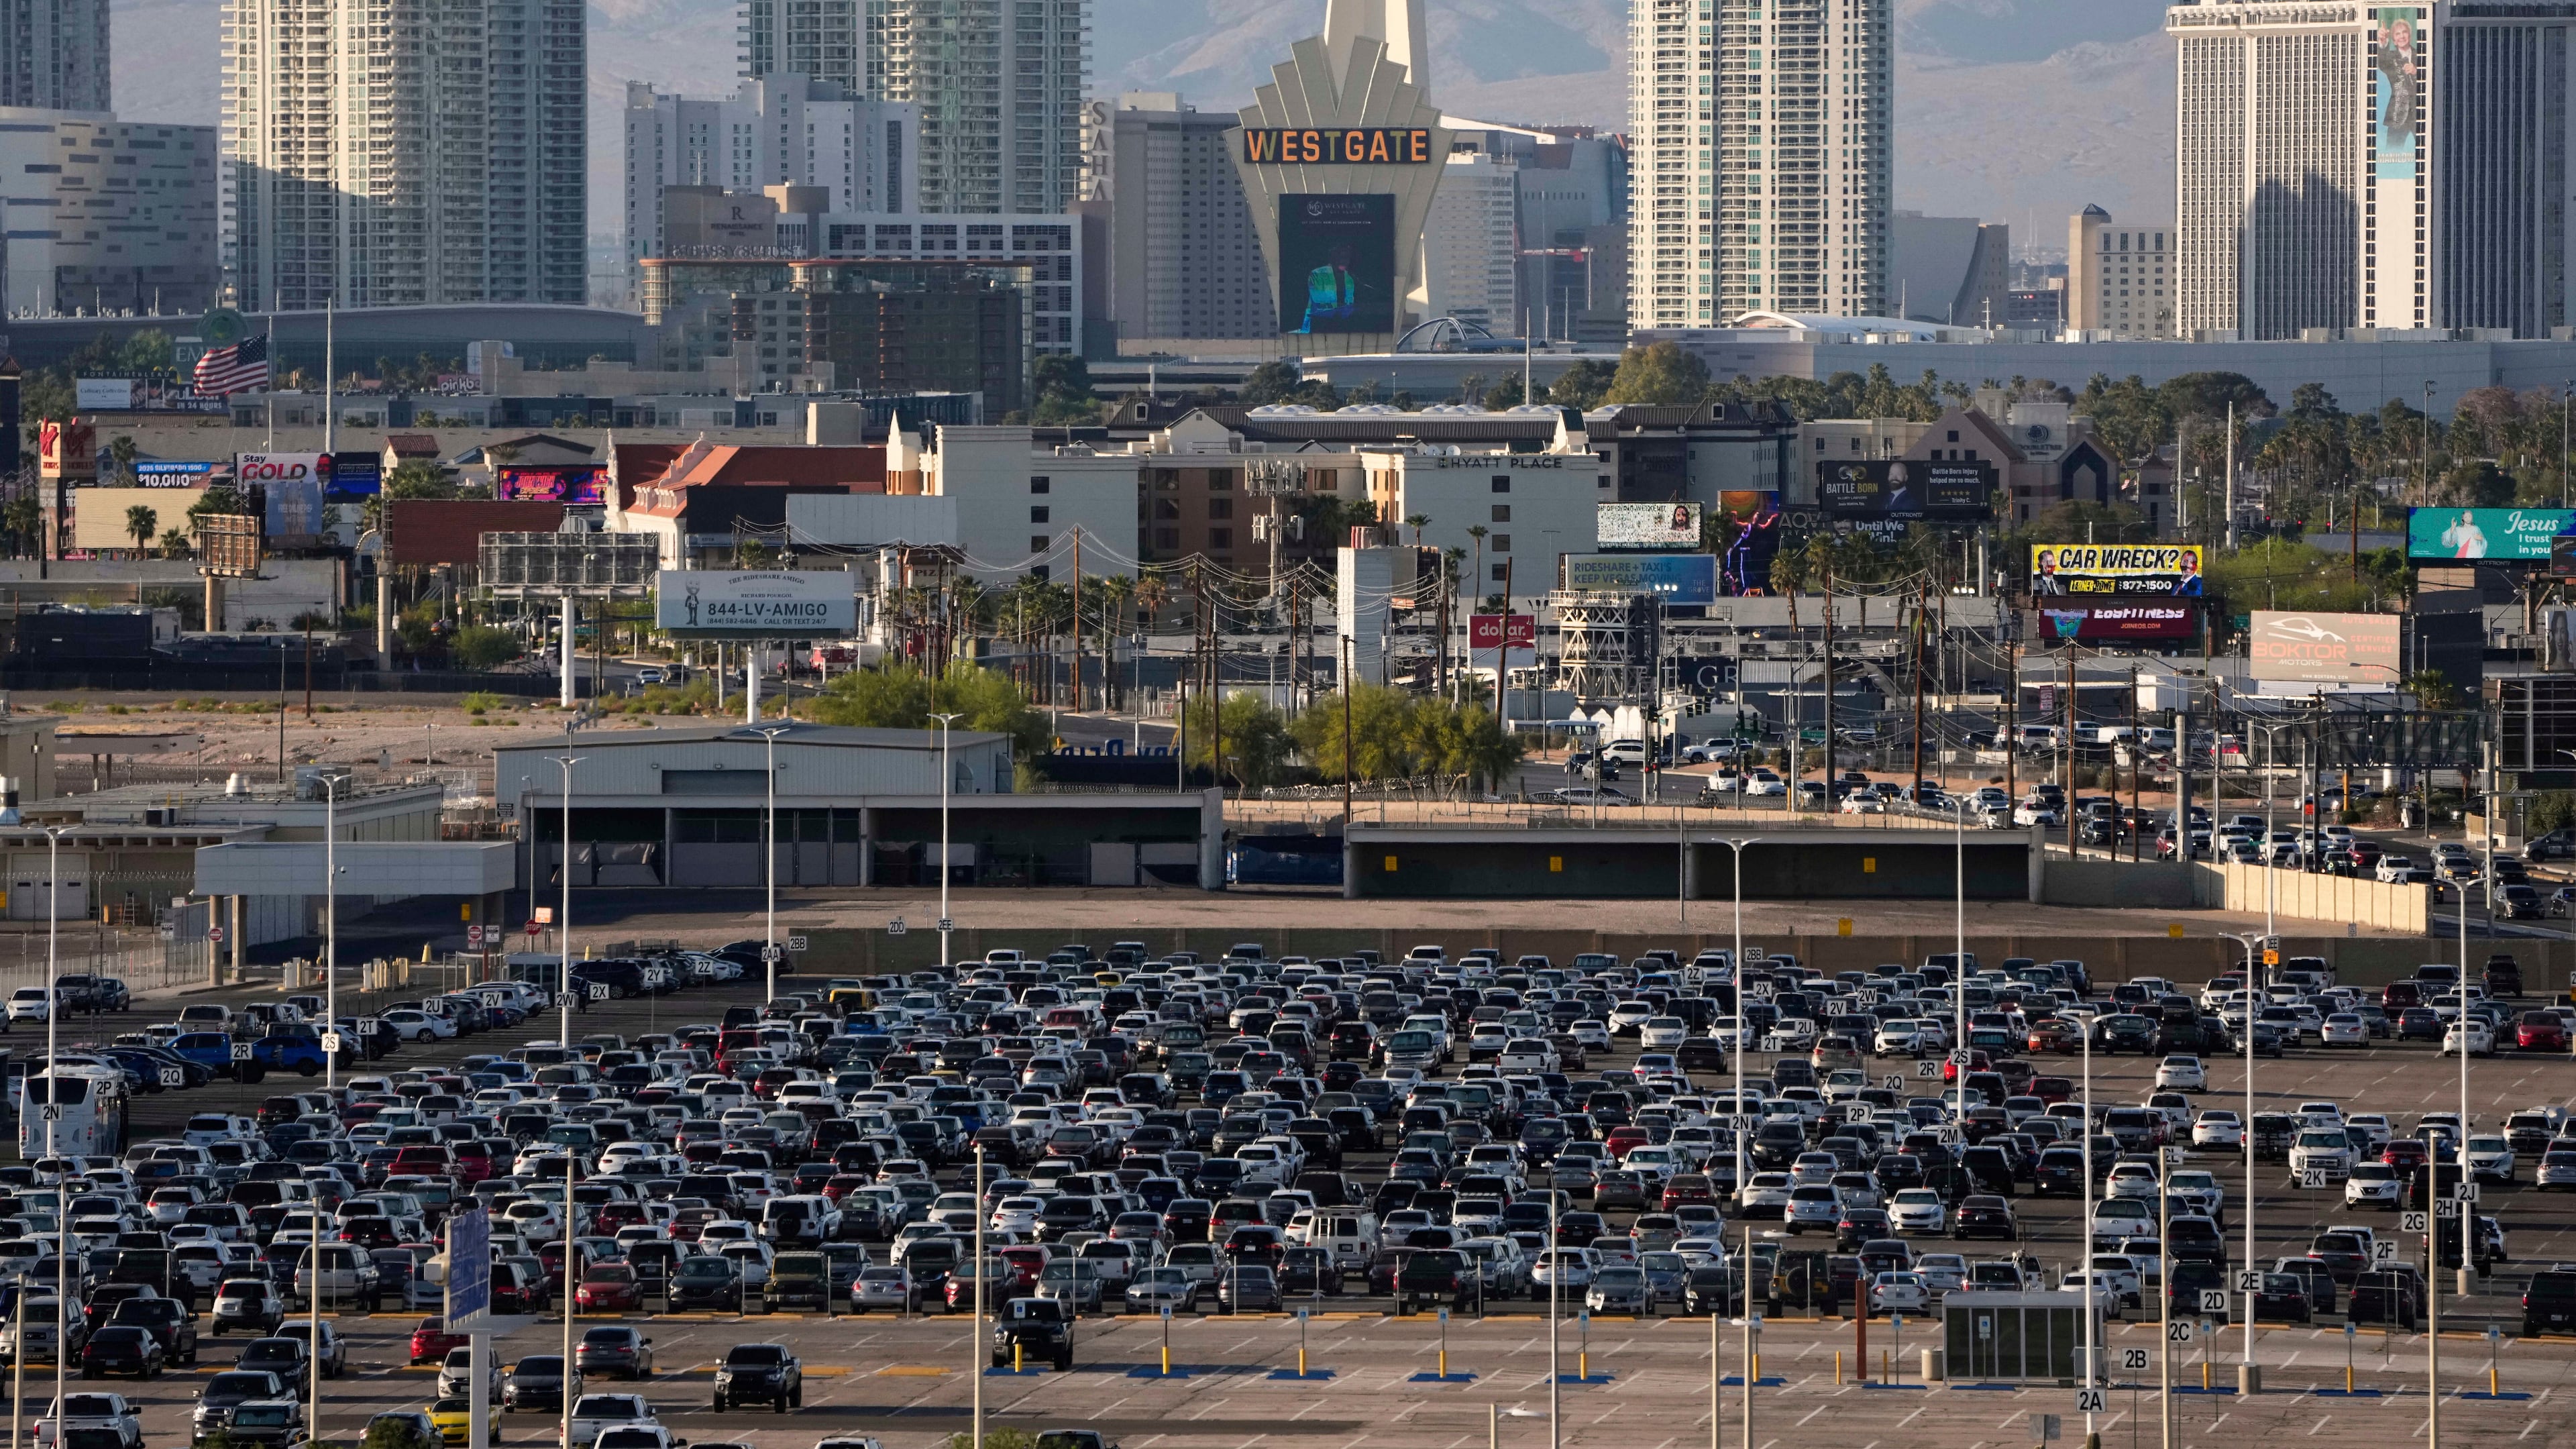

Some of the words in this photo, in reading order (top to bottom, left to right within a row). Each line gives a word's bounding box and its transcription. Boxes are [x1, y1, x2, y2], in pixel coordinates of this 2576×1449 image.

[1247, 131, 1427, 162] WESTGATE
[243, 455, 266, 464] Stay
[1451, 458, 1501, 468] HYATT
[1510, 458, 1562, 468] PLACE
[242, 463, 307, 480] GOLD
[1826, 483, 1855, 494] BATTLE
[1857, 482, 1878, 493] BORN
[1856, 521, 1883, 531] Until
[1885, 521, 1904, 531] We
[2504, 511, 2559, 534] Jesus
[2518, 534, 2522, 542] I
[2524, 534, 2550, 542] trust
[2519, 545, 2529, 553] in
[2531, 546, 2551, 555] you
[2059, 549, 2097, 569] CAR
[2101, 549, 2180, 569] WRECK?
[1574, 563, 1630, 572] RIDESHARE
[1640, 563, 1672, 572] TAXI'S
[728, 576, 742, 585] THE
[782, 576, 805, 585] AMIGO
[1574, 574, 1599, 584] KEEP
[1603, 574, 1638, 584] VEGAS
[1639, 574, 1682, 584] MOVING
[2122, 580, 2172, 590] 877-1500
[708, 603, 827, 616] 844-LV-AMIGO
[1479, 620, 1526, 637] dolar.
[2350, 636, 2397, 644] CERTIFIED
[2253, 642, 2347, 659] BOKTOR
[2355, 645, 2393, 653] SERVICE
[2364, 673, 2383, 681] TINT
[890, 922, 904, 932] 2DD
[938, 920, 952, 930] 2EE
[790, 938, 805, 949] 2BB
[763, 949, 778, 960] 2AA
[1747, 949, 1762, 960] 2BB
[698, 961, 710, 973] 2Z
[1687, 968, 1700, 979] 2Z
[647, 969, 661, 981] 2Y
[592, 986, 606, 998] 2X
[1756, 983, 1770, 995] 2X
[486, 994, 499, 1006] 2V
[556, 994, 574, 1006] 2W
[1859, 990, 1876, 1002] 2W
[425, 1000, 439, 1012] 2U
[1830, 1002, 1843, 1015] 2V
[360, 1020, 374, 1033] 2T
[1799, 1022, 1811, 1034] 2U
[325, 1036, 335, 1049] 2S
[1764, 1037, 1778, 1050] 2T
[233, 1044, 249, 1058] 2R
[1954, 1051, 1968, 1063] 2S
[1920, 1063, 1935, 1076] 2R
[163, 1070, 180, 1084] 2Q
[1886, 1076, 1902, 1090] 2Q
[96, 1081, 111, 1094] 2P
[43, 1106, 59, 1120] 2N
[1850, 1108, 1865, 1122] 2P
[1733, 1116, 1748, 1130] 2N
[1940, 1129, 1957, 1143] 2M
[2305, 1171, 2322, 1185] 2K
[2460, 1185, 2475, 1200] 2J
[2436, 1200, 2453, 1216] 2H
[2405, 1214, 2424, 1230] 2G
[2377, 1242, 2394, 1258] 2F
[2241, 1273, 2259, 1290] 2E
[2205, 1292, 2224, 1309] 2D
[2170, 1323, 2190, 1341] 2C
[2125, 1350, 2146, 1368] 2B
[2080, 1391, 2102, 1411] 2A
